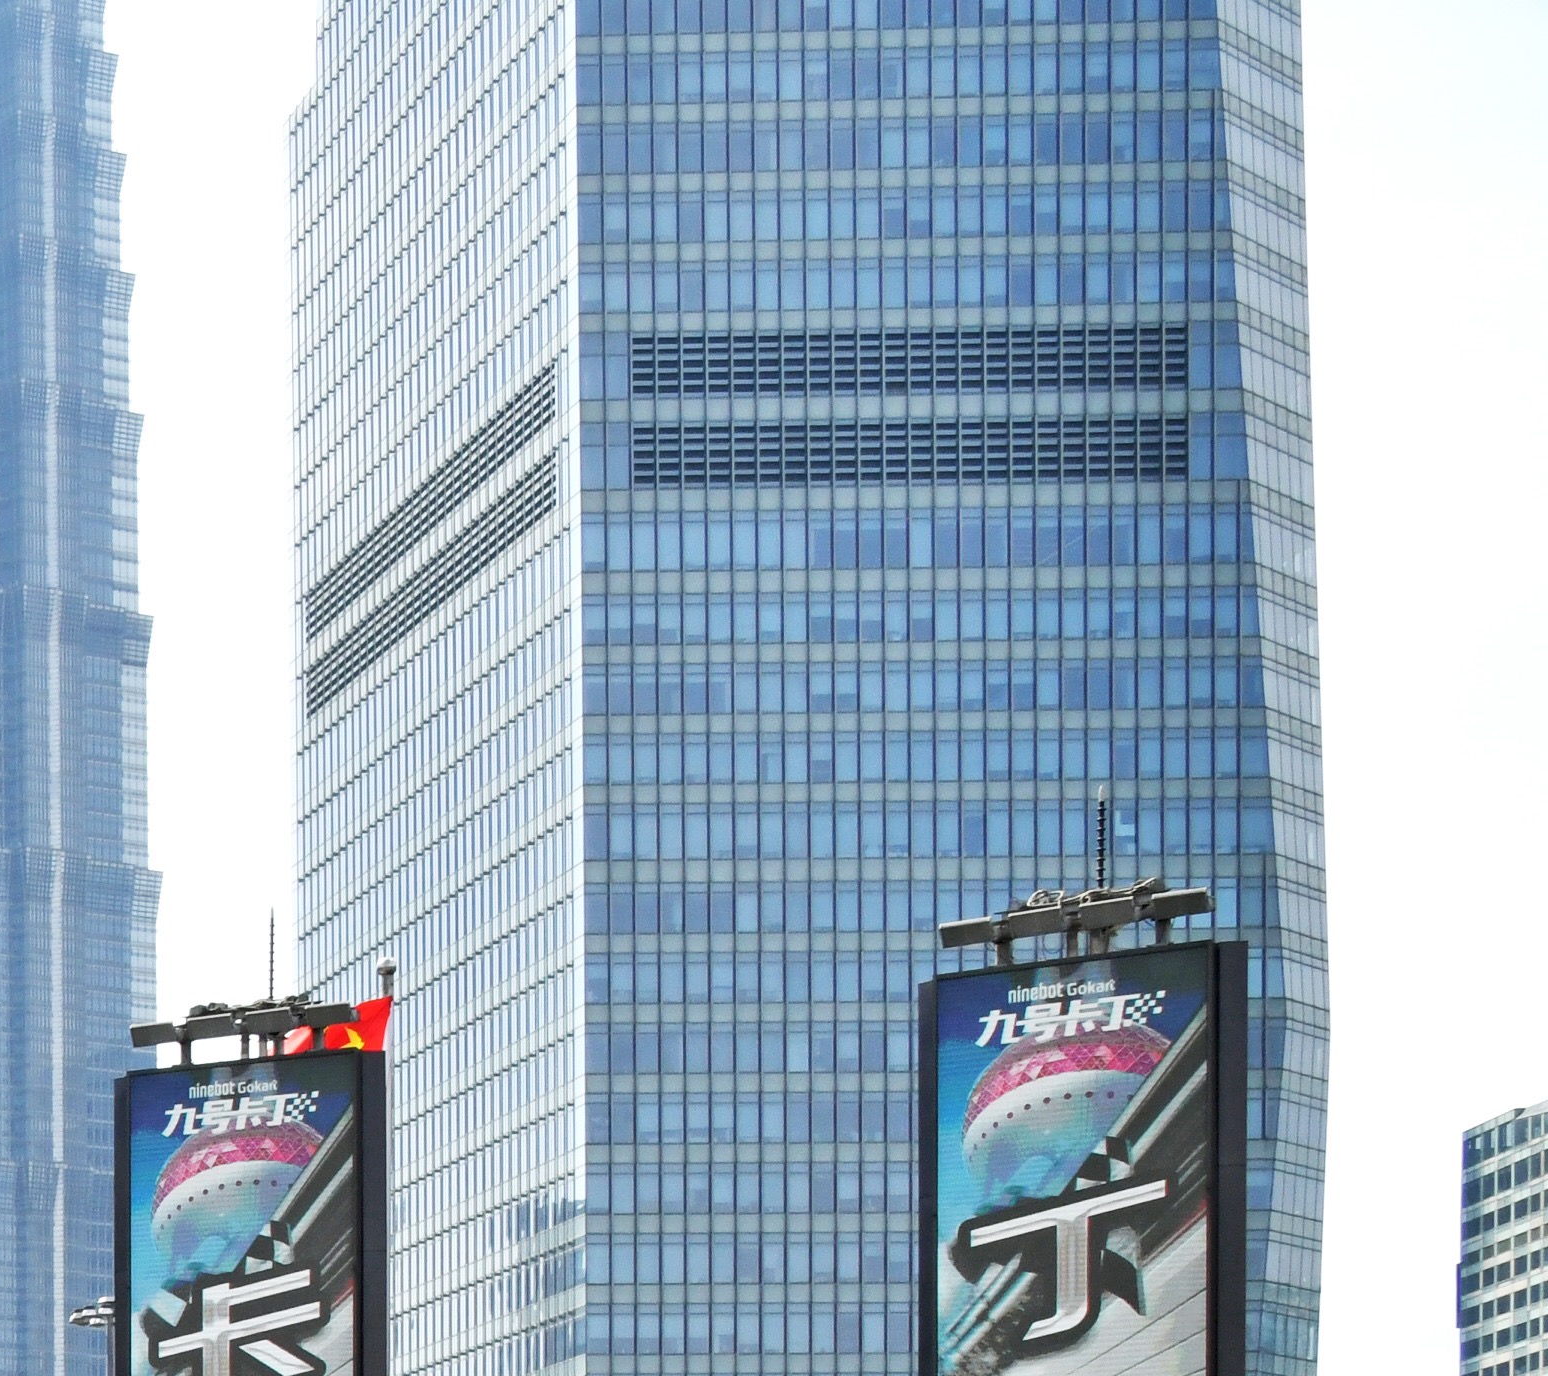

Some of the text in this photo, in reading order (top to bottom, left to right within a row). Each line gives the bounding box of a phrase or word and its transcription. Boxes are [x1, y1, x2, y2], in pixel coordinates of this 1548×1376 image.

[1008, 979, 1117, 1005] ninebot Gokart
[978, 995, 1141, 1048] 九号卡丁
[188, 1079, 278, 1100] ninebot Gokart
[163, 1092, 294, 1137] 九号卡丁
[970, 1180, 1167, 1341] 丁
